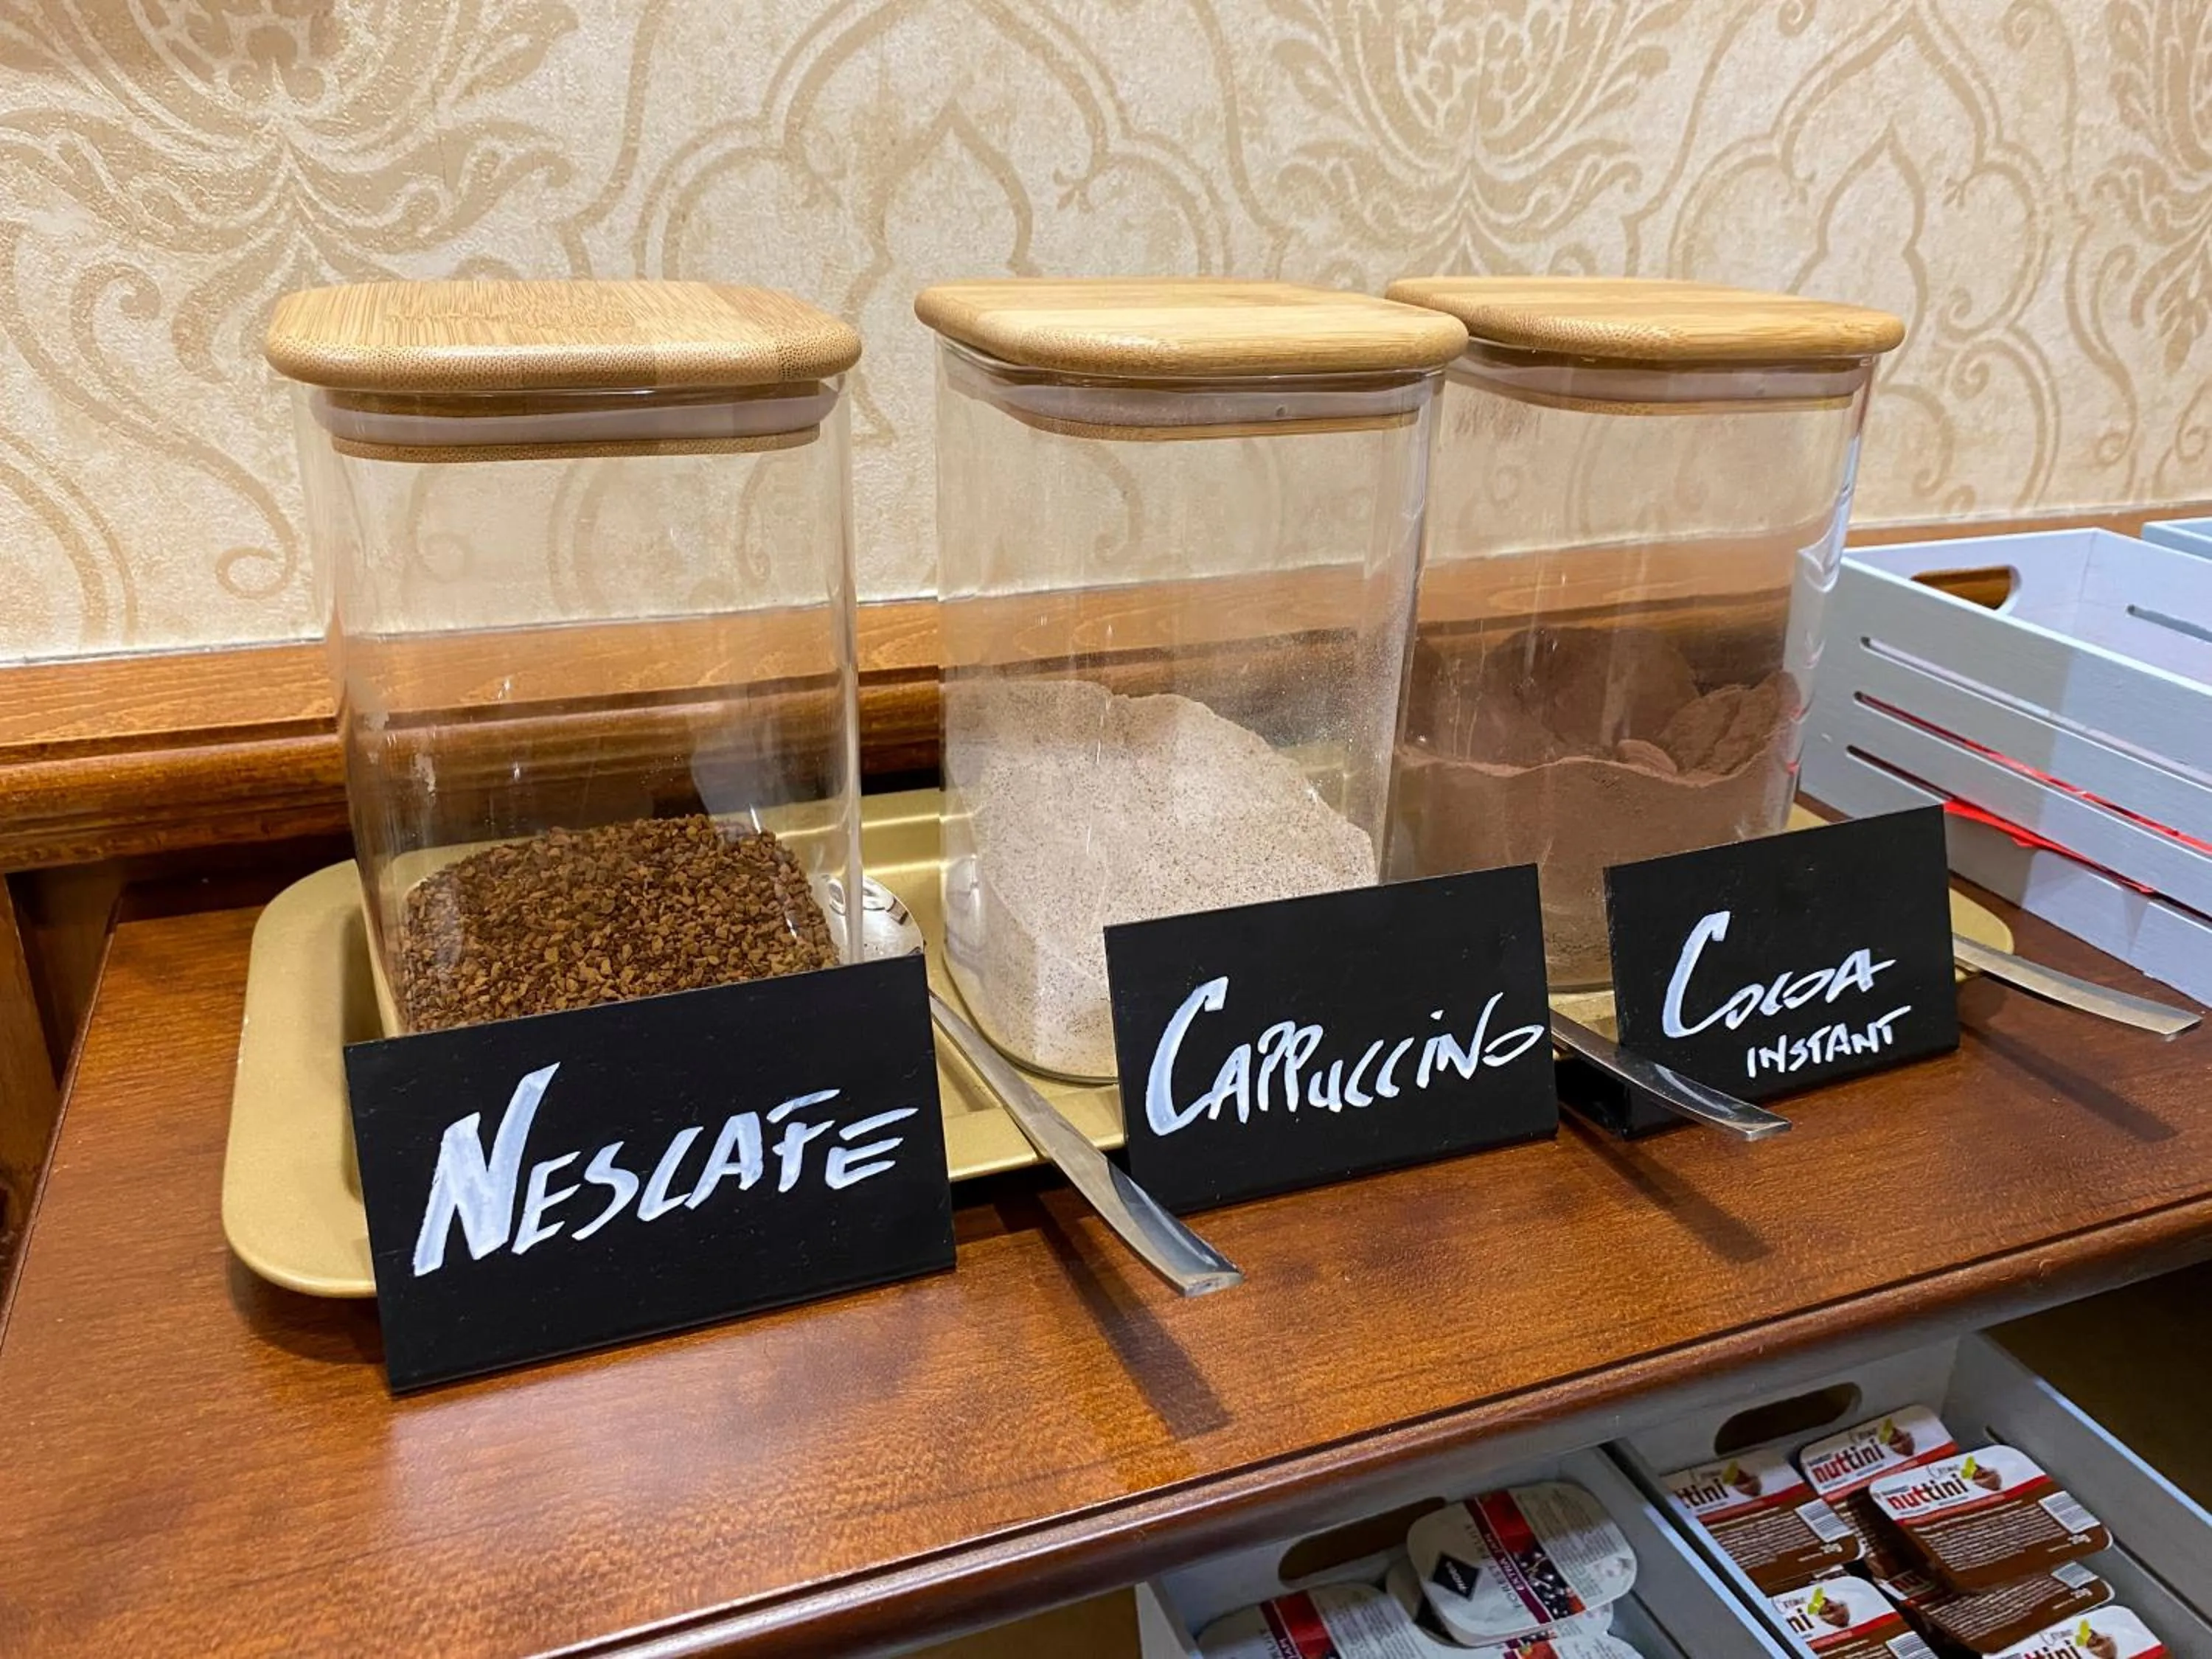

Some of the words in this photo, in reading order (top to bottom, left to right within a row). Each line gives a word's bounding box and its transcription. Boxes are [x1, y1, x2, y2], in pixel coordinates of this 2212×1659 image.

[1662, 911, 1896, 1039] COCOA
[1145, 975, 1545, 1136] CAPPUCCINO
[1747, 1005, 1912, 1078] INSTANT
[412, 1060, 919, 1277] NESCAFE
[1673, 1477, 1730, 1509] ttini
[1812, 1439, 1885, 1484] nuttini
[1886, 1473, 1969, 1510] nuttini
